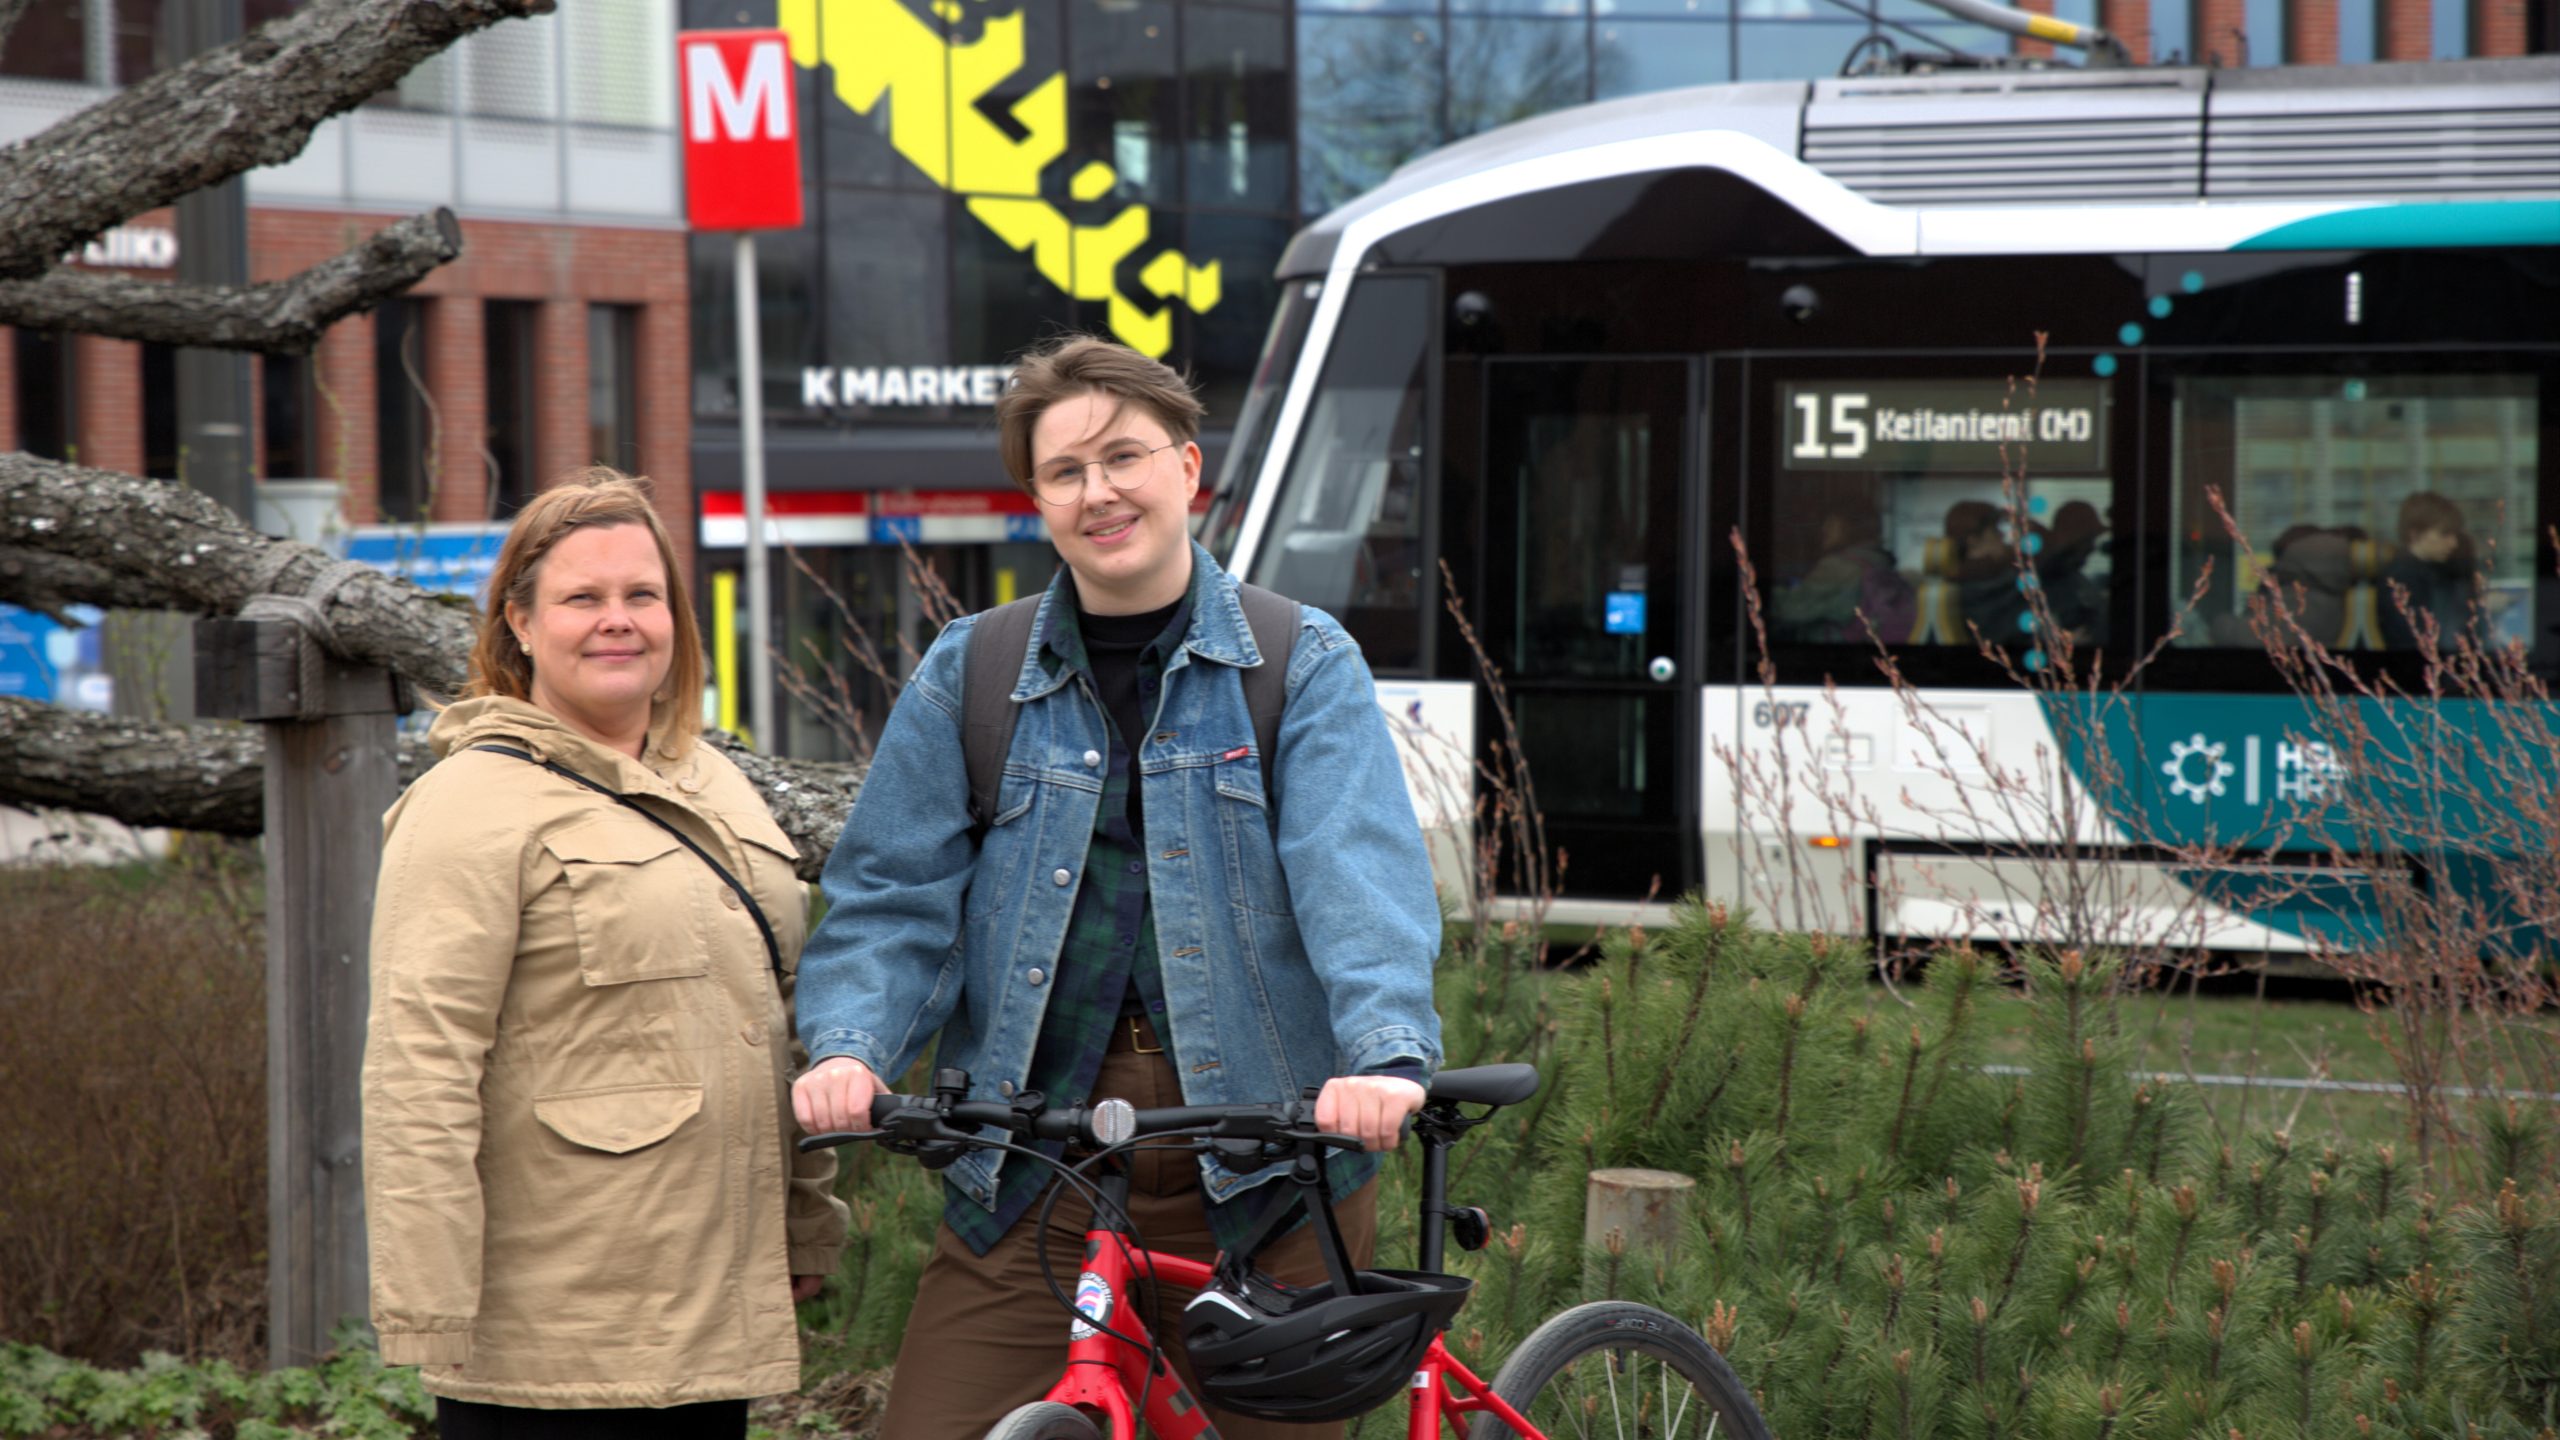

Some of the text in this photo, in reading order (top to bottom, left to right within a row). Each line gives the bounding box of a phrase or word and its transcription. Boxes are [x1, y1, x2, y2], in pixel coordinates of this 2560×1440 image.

[687, 42, 790, 141] M
[803, 366, 835, 406] K
[1794, 394, 2092, 458] 15 Keilaniemi (M)
[1754, 701, 1810, 729] 607
